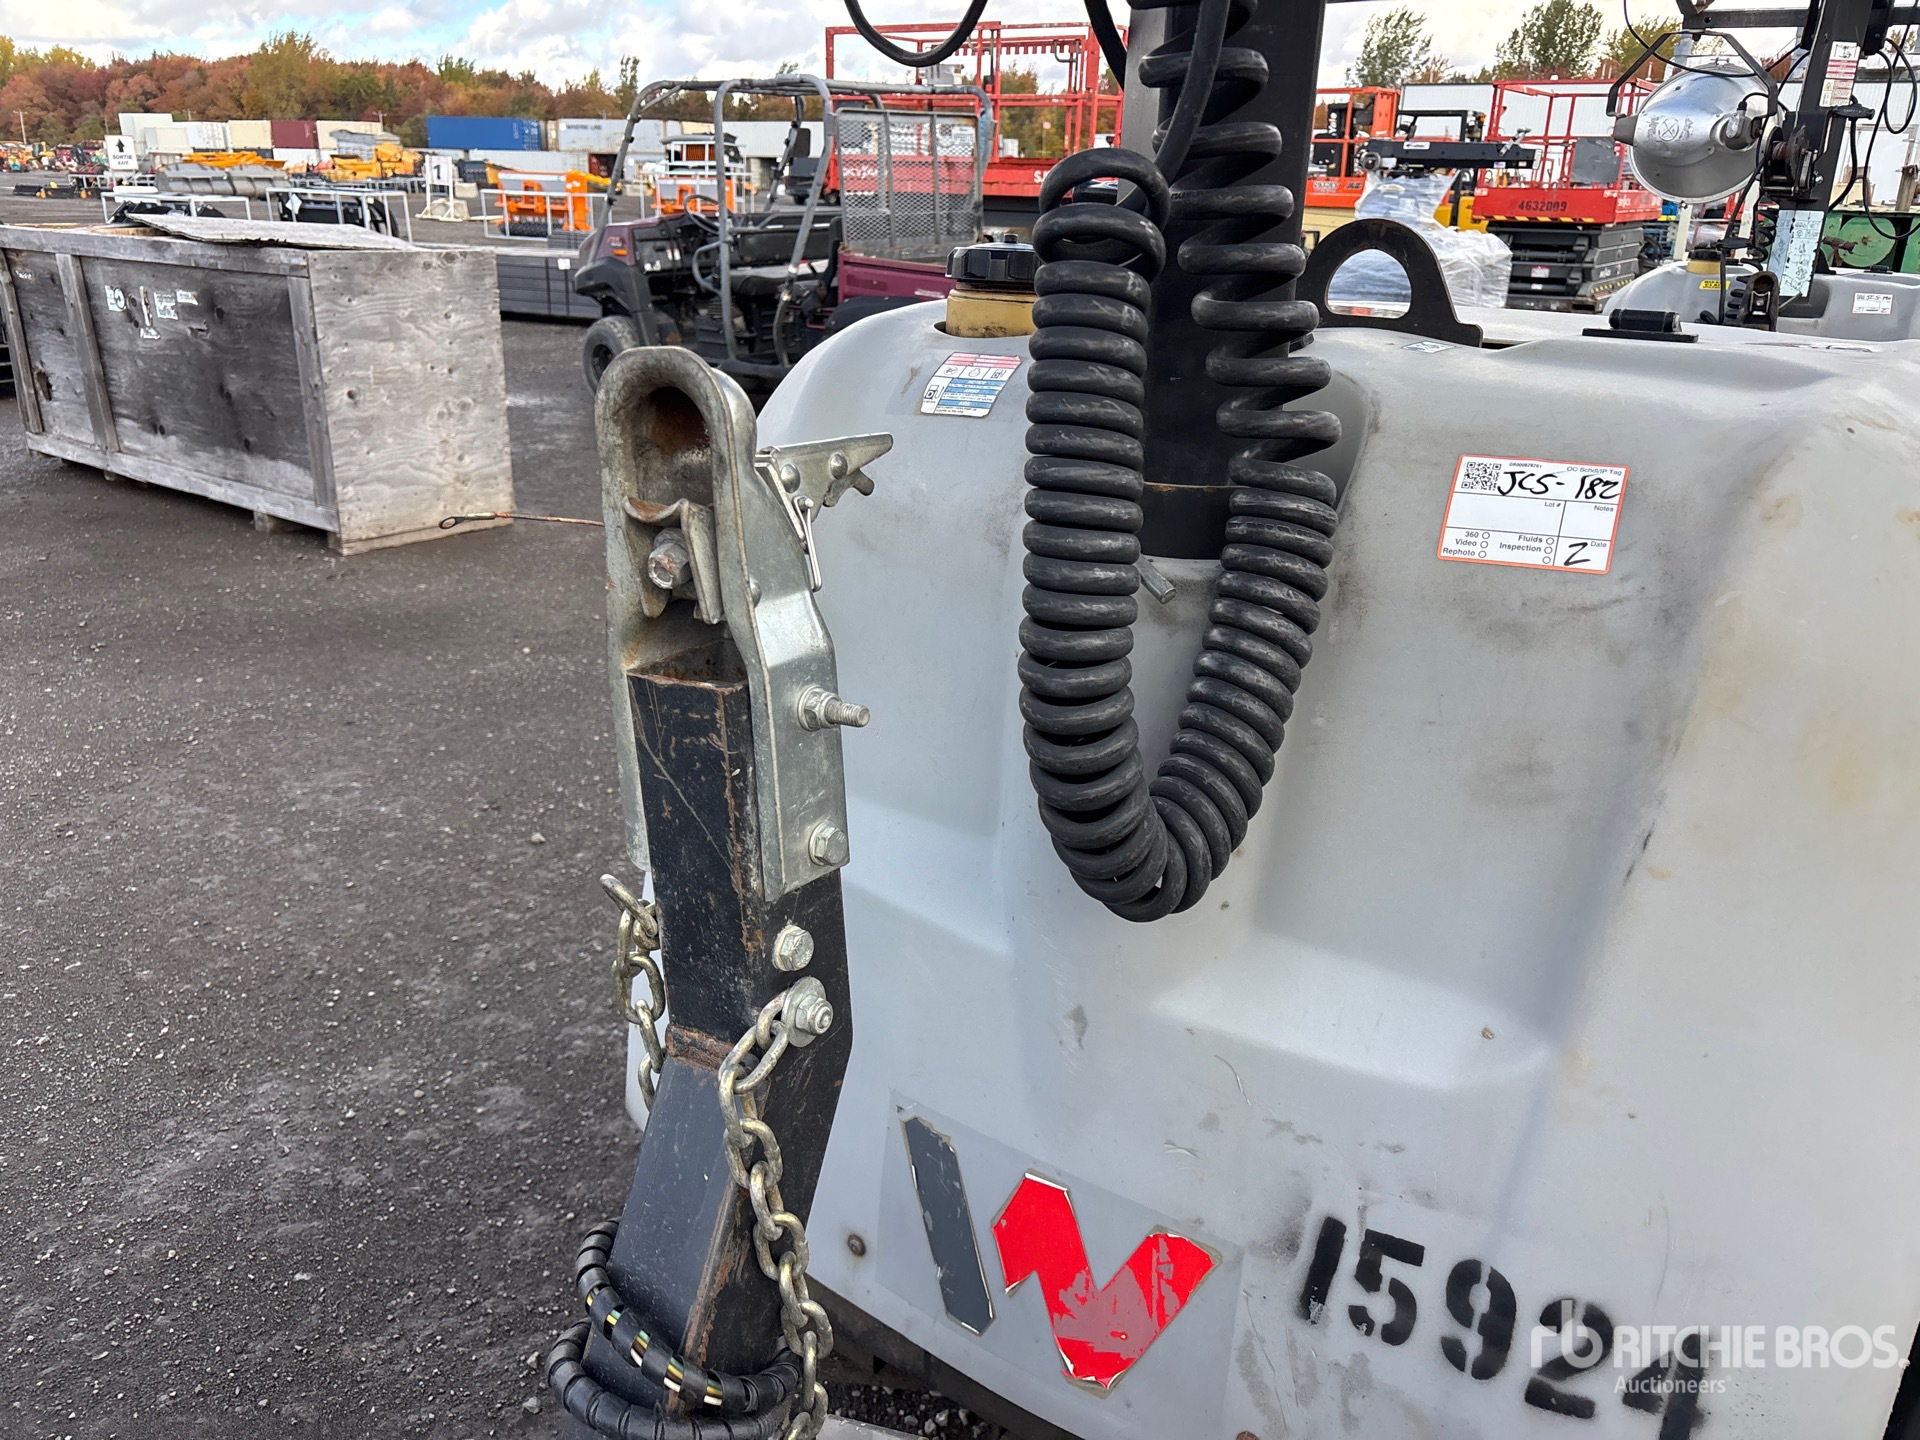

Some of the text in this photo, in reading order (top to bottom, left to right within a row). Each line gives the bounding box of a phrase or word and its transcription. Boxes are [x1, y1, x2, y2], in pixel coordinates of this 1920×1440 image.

[432, 163, 442, 180] 1
[1518, 200, 1567, 212] 4632009
[1455, 538, 1477, 547] Video
[1518, 535, 1543, 543] Fluids
[1442, 547, 1475, 557] Rephoto
[1499, 542, 1542, 553] Inspection
